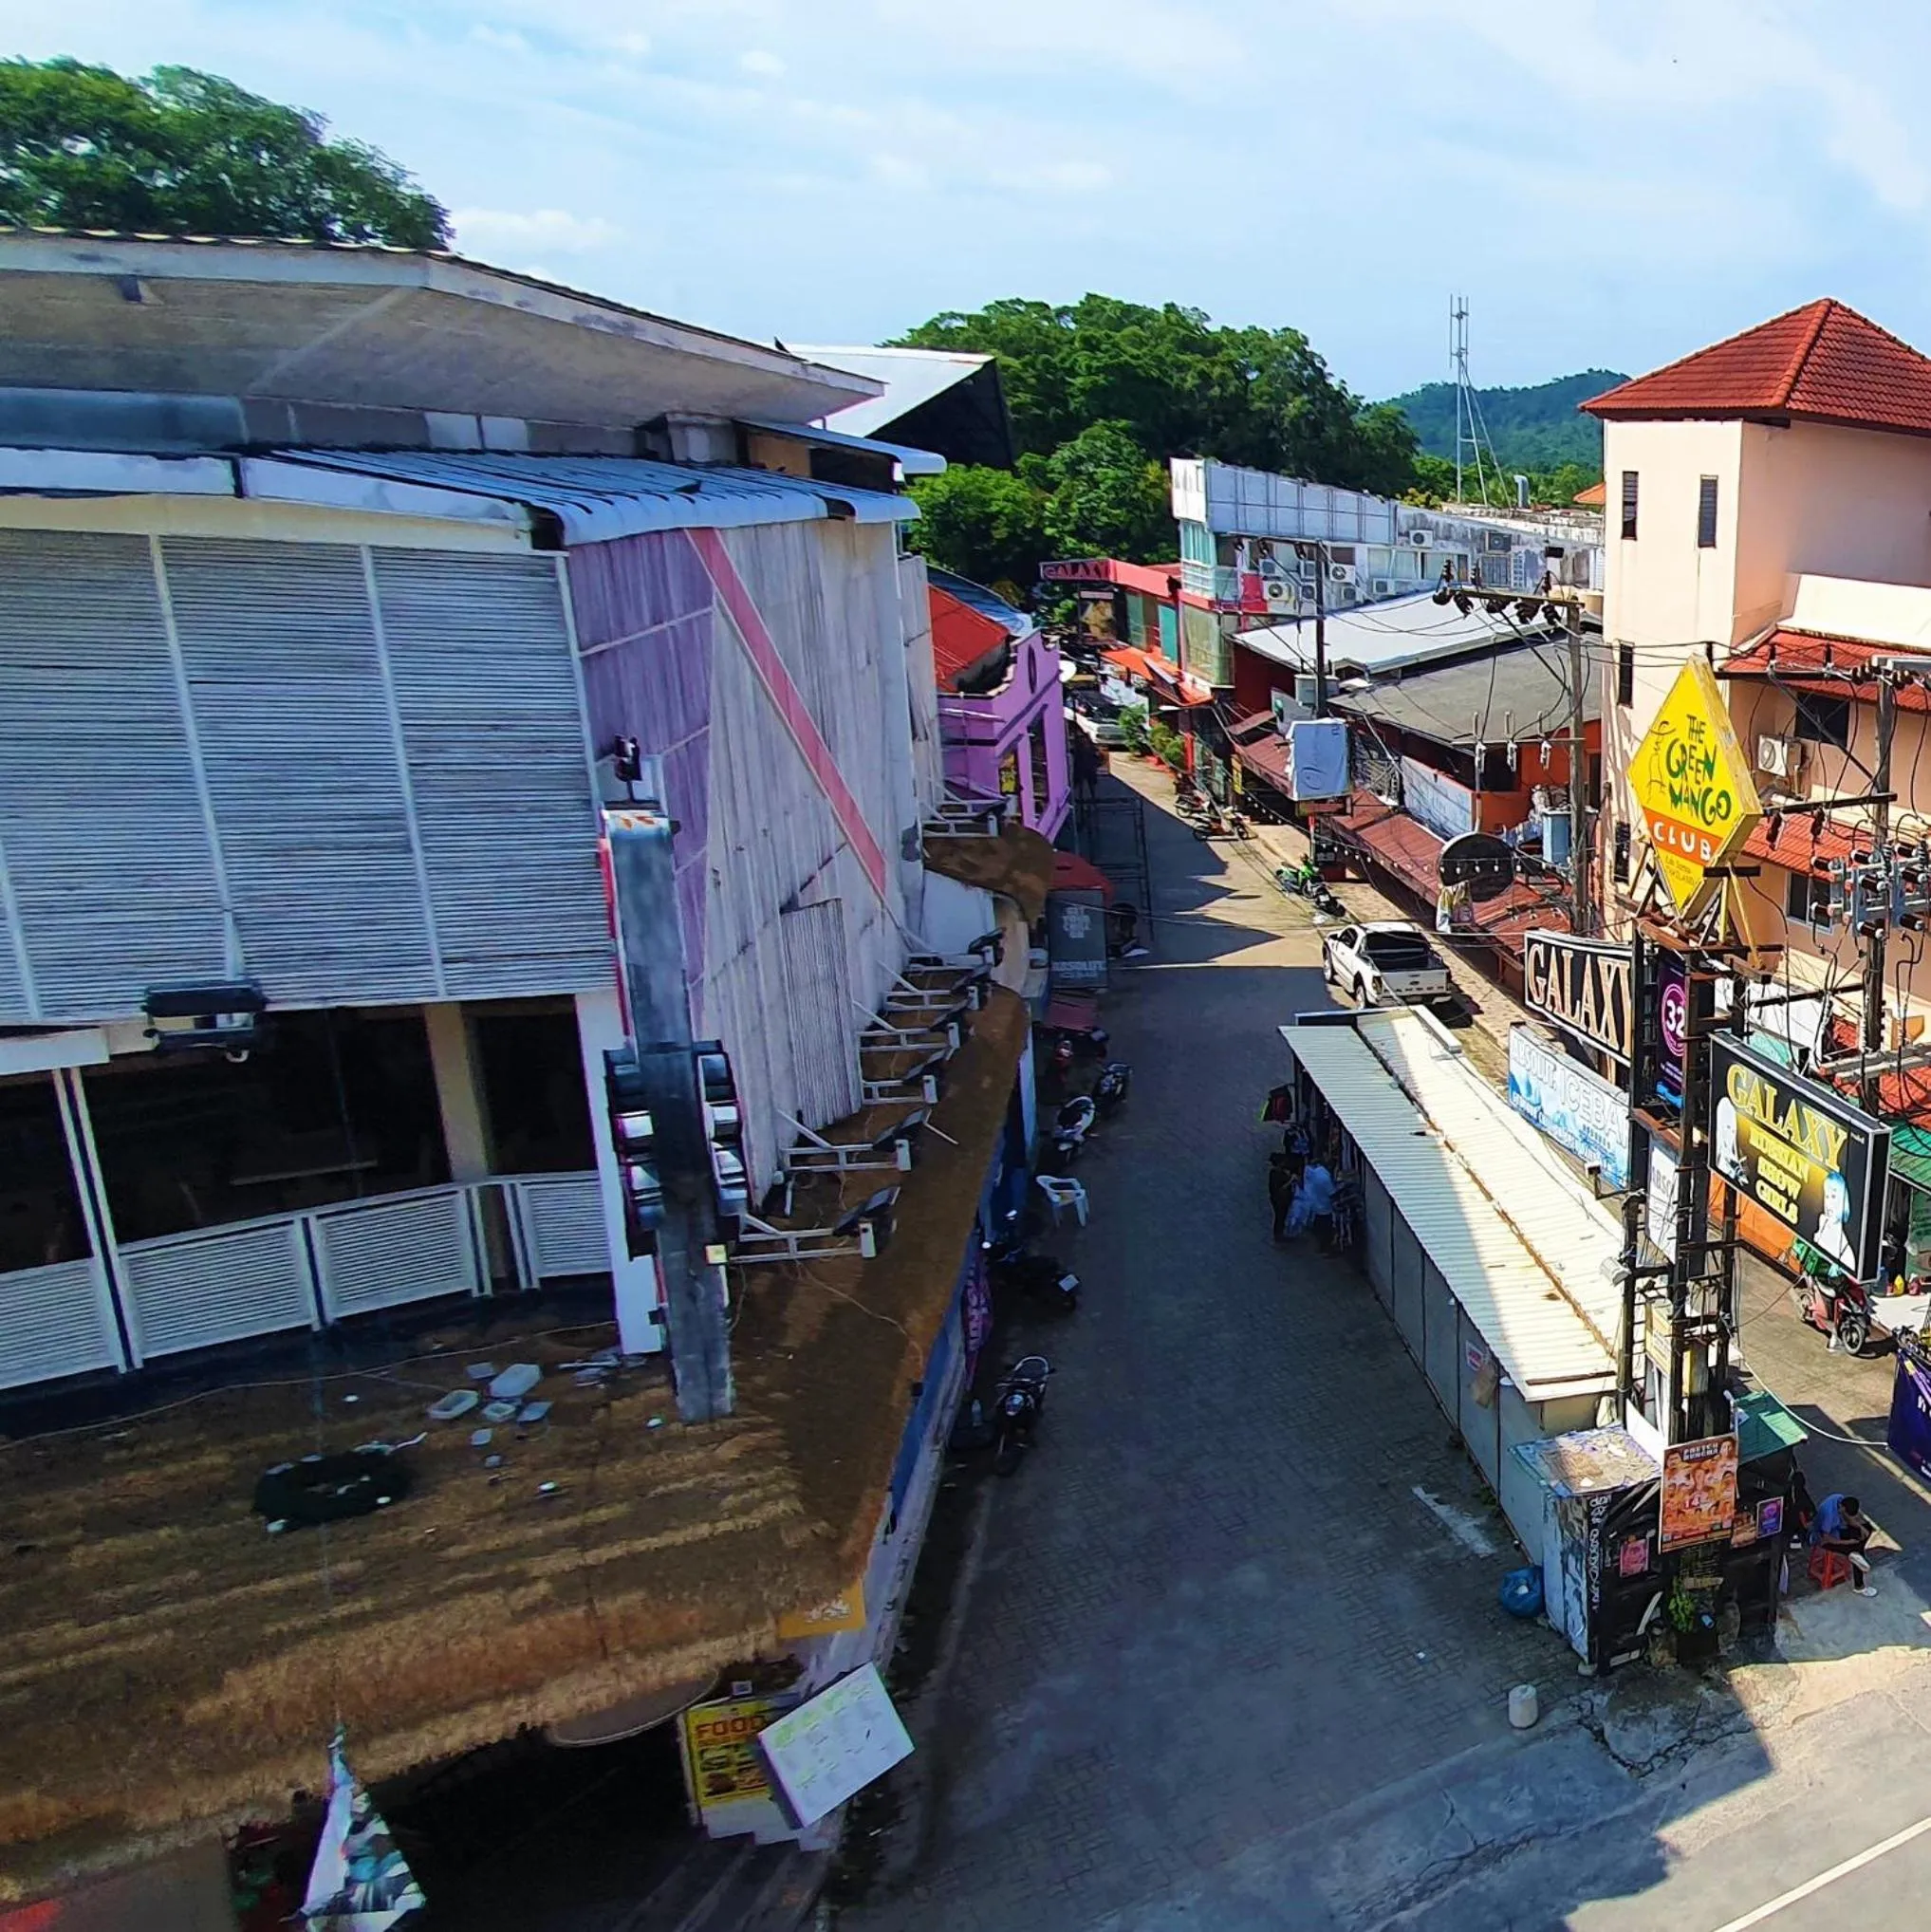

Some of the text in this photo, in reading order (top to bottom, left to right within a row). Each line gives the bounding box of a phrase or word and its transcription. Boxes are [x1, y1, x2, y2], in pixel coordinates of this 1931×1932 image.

[1686, 714, 1706, 744] THE
[1666, 737, 1717, 786] GREEN
[1669, 781, 1732, 827] MANGO
[1653, 821, 1712, 862] CLUB
[1666, 999, 1685, 1038] 32
[1560, 1067, 1629, 1150] ICEBA
[1727, 1063, 1848, 1172] GALAXY
[1757, 1155, 1802, 1200] SHOW
[1755, 1179, 1799, 1224] GIRLS
